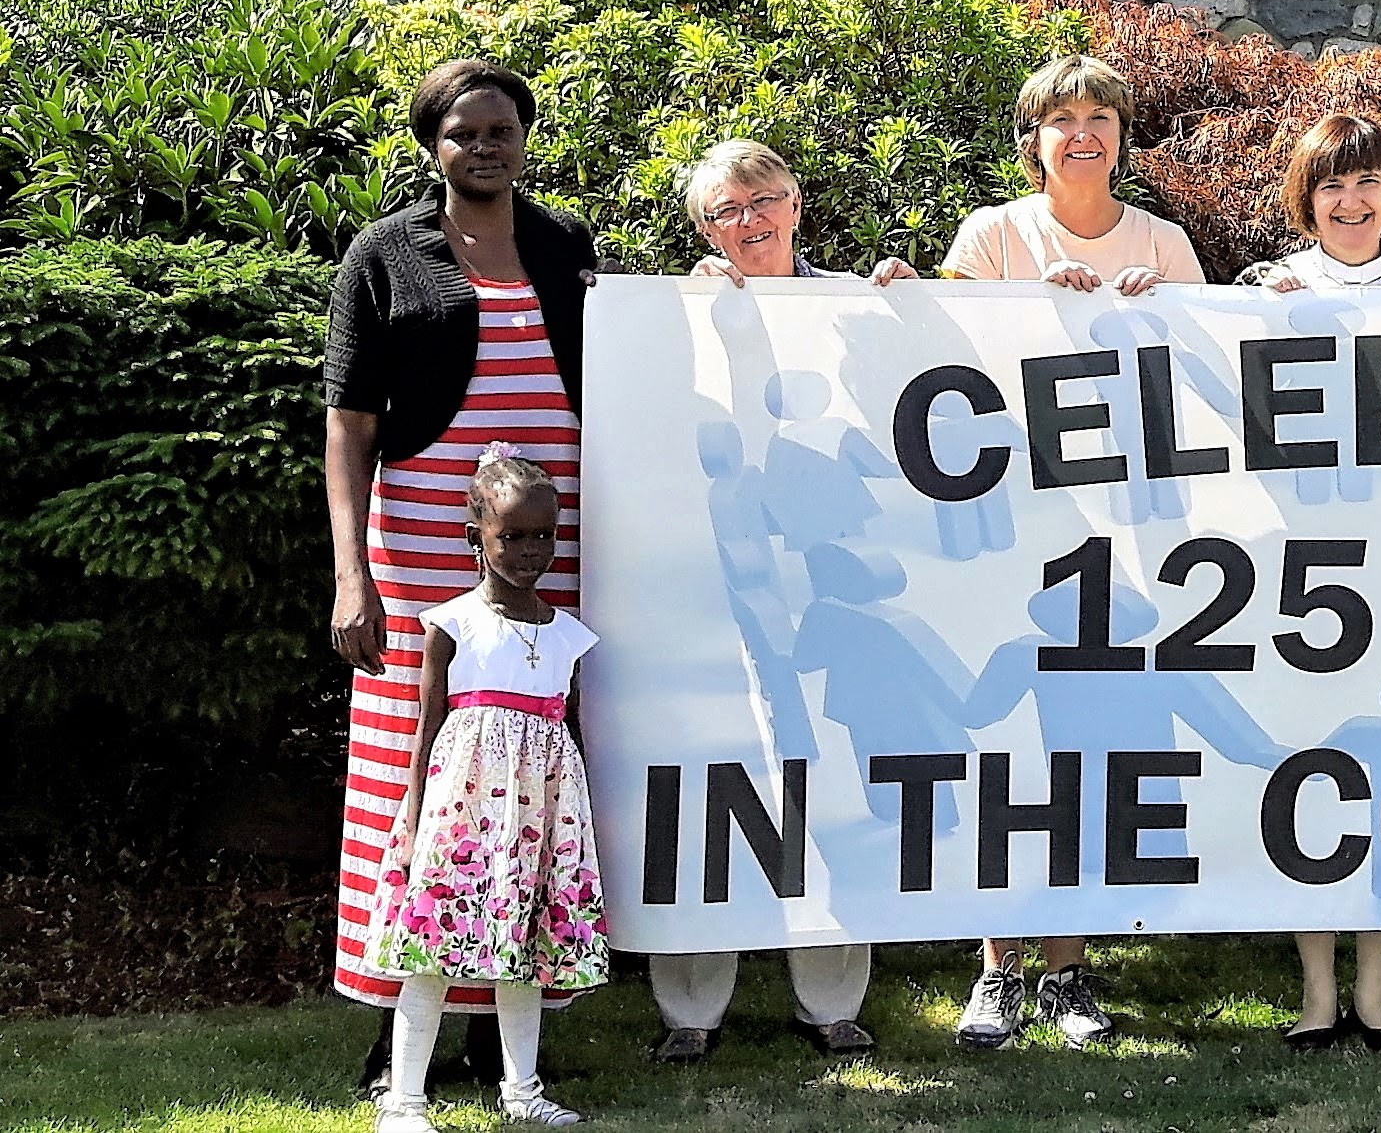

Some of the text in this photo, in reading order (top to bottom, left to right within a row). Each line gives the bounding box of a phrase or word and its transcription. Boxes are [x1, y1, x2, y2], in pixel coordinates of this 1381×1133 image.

[1038, 537, 1373, 674] 125
[642, 758, 808, 905] IN
[868, 751, 1202, 893] THE
